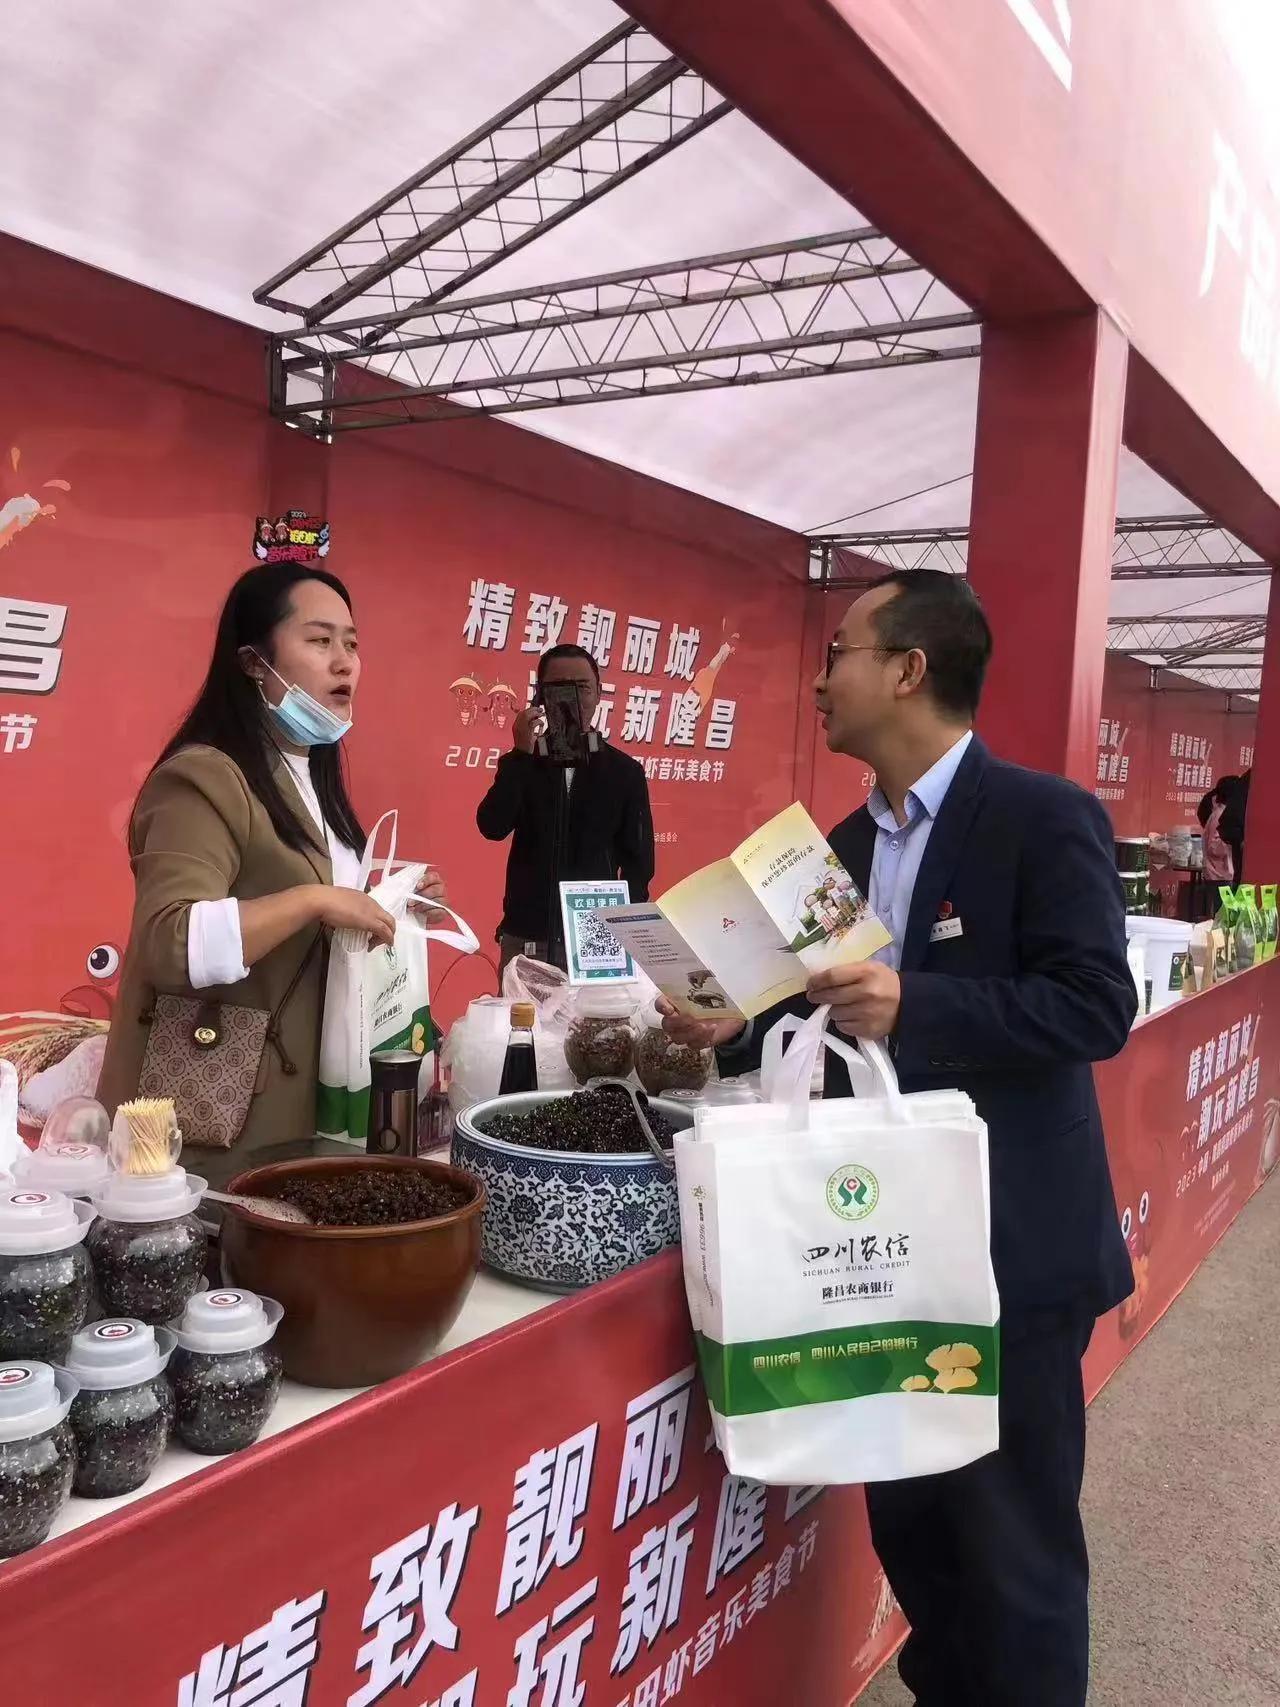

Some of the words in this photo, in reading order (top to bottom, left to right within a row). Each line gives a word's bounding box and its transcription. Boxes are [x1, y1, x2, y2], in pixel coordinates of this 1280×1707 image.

[0, 597, 68, 696] 昌
[463, 578, 700, 682] 精致靓丽城
[0, 713, 38, 753] 节
[445, 745, 511, 769] 202
[574, 897, 618, 908] 欢迎使用
[1186, 1013, 1253, 1102] 精致靓丽城
[1197, 1056, 1260, 1150] 潮玩新隆昌
[802, 1233, 910, 1264] 四川农信
[802, 1267, 841, 1277] SICHUAN
[846, 1264, 875, 1272] RURAL
[880, 1260, 911, 1270] CREDIT
[821, 1280, 894, 1300] 隆昌农商银行
[753, 1351, 801, 1369] 四川农信
[811, 1336, 919, 1360] 四川人民自己的银行
[175, 1364, 717, 1707] 精致靓丽
[616, 1520, 820, 1707] 田虾音乐美食节
